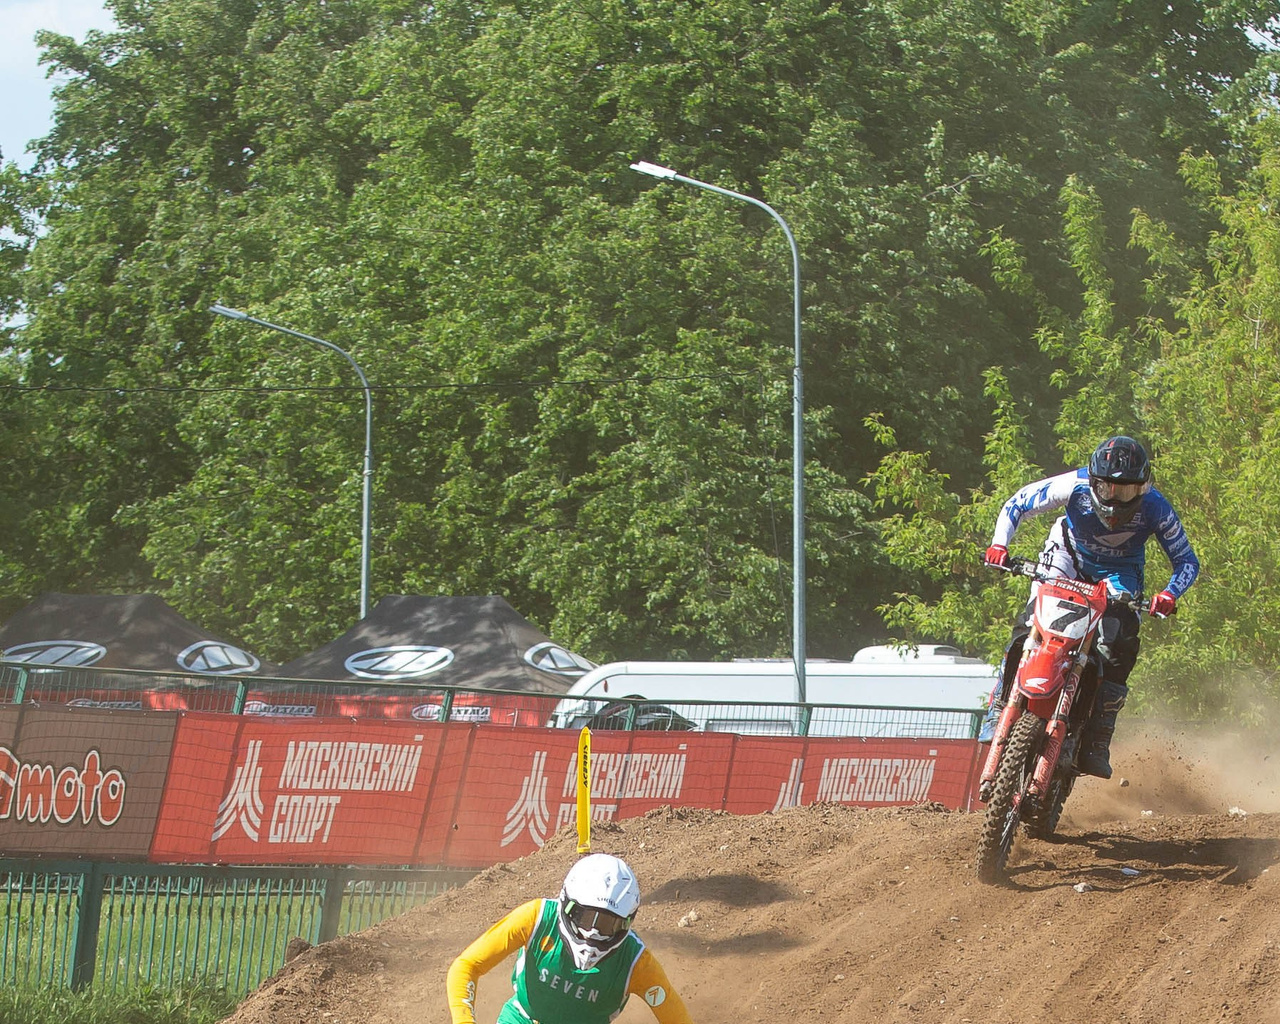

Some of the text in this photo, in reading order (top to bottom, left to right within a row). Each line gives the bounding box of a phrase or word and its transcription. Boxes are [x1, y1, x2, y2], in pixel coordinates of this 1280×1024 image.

[1048, 600, 1090, 633] 7
[279, 734, 424, 792] МОСКОВСКИЙ
[816, 749, 937, 802] МОСКОВСКИЙ
[268, 795, 342, 844] СПОРТ
[538, 968, 600, 1003] SEVEN
